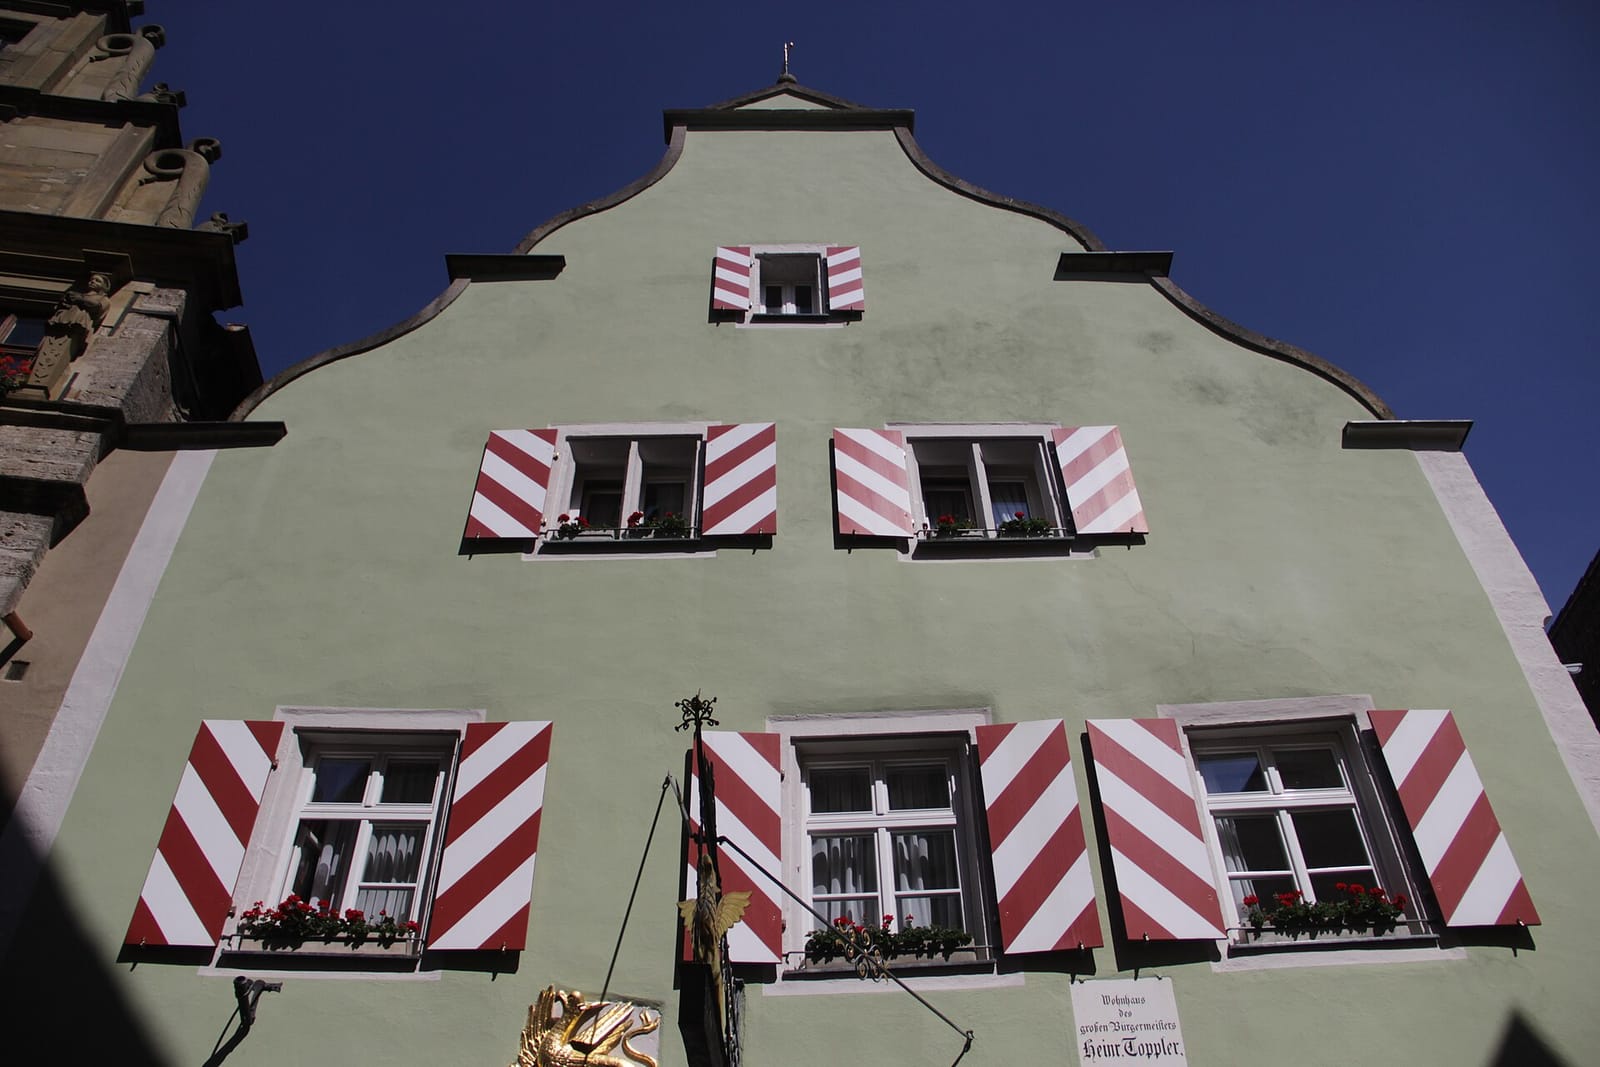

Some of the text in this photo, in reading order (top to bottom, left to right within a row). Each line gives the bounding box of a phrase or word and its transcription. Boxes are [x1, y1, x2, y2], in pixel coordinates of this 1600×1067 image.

[1101, 994, 1146, 1006] Wohnhaus
[1118, 1009, 1133, 1018] des
[1080, 1022, 1109, 1035] großen
